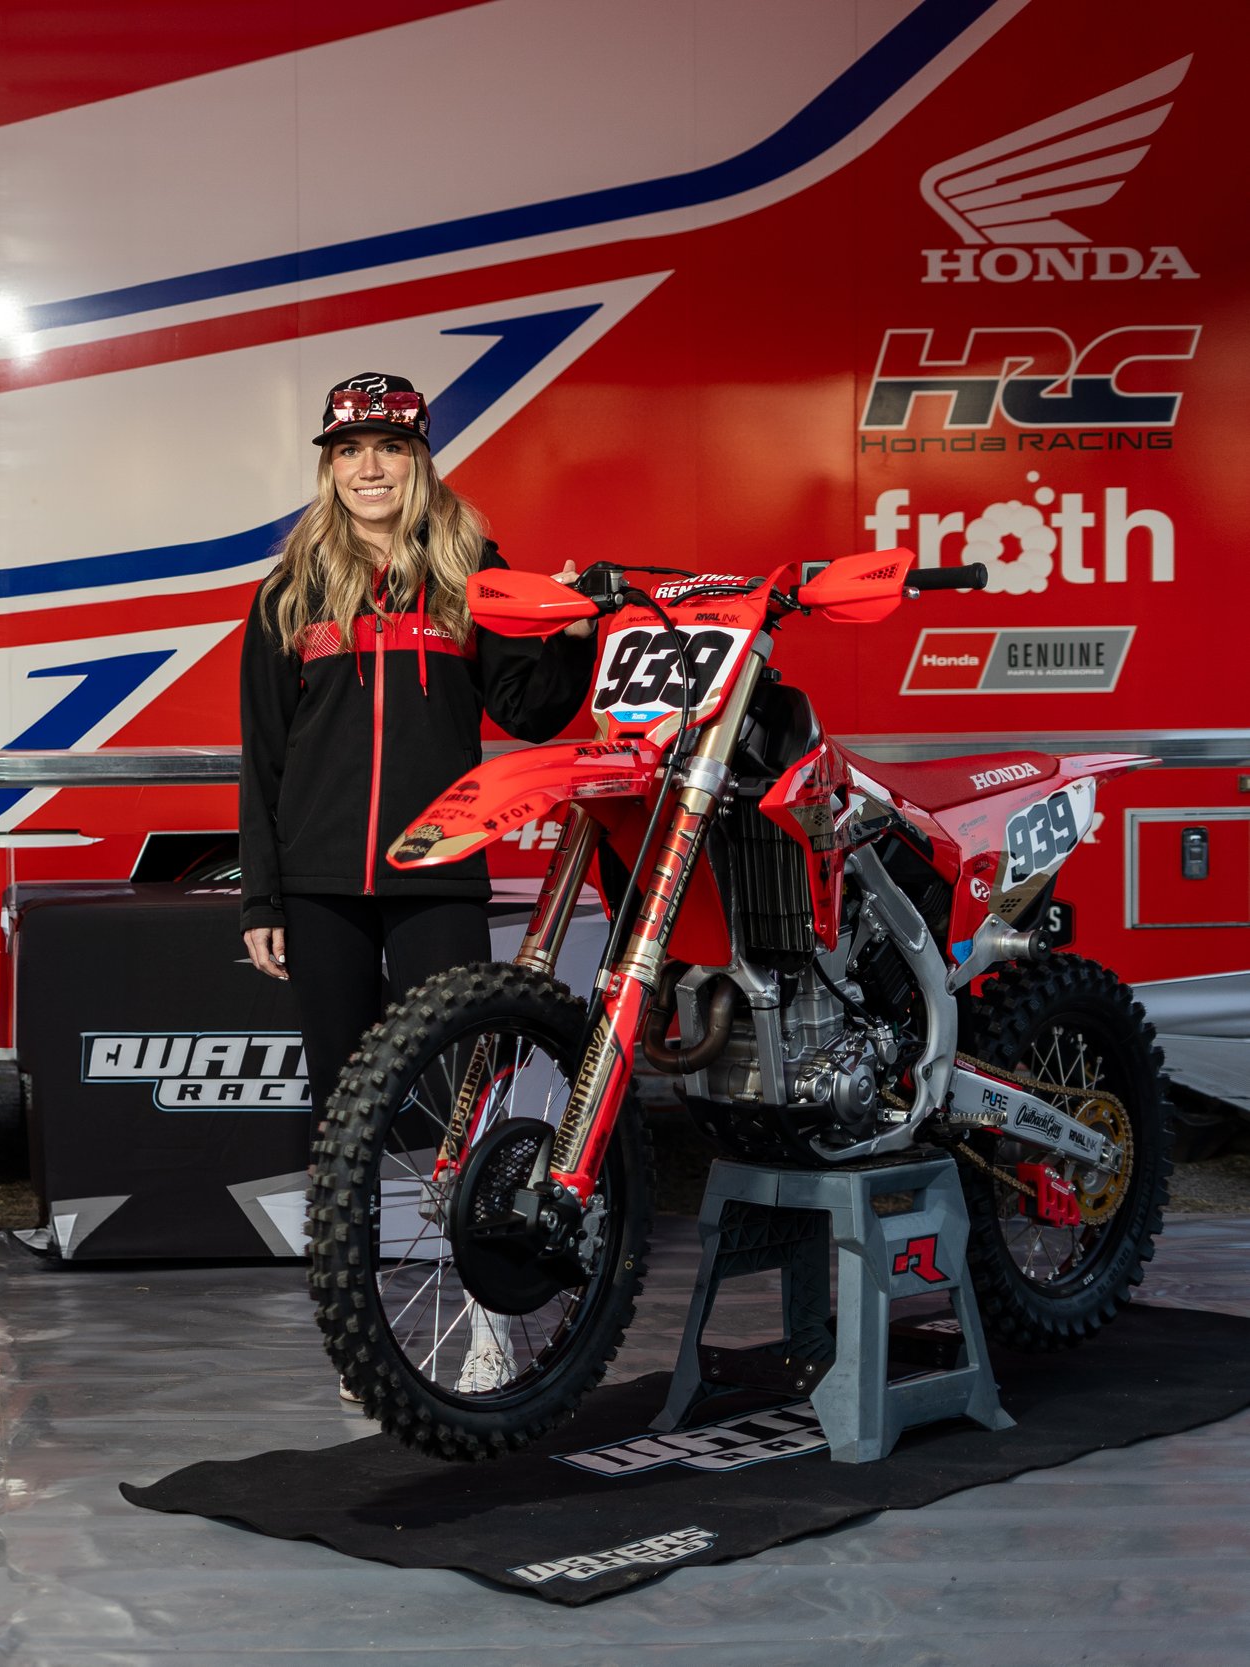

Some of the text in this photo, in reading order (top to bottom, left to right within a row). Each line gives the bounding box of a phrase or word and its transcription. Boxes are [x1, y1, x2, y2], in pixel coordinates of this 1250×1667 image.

[921, 246, 1201, 283] HONDA
[859, 325, 1202, 430] HRC
[861, 431, 1173, 453] Honda RACING
[864, 487, 1174, 594] froth
[694, 612, 720, 621] RIVAL
[722, 614, 741, 623] INK
[412, 627, 453, 639] OND
[922, 654, 979, 666] Honda
[1007, 643, 1105, 667] GENUINE
[594, 630, 734, 710] 939
[970, 763, 1041, 790] HONDA
[501, 804, 534, 823] FOX
[1007, 791, 1078, 883] 939
[657, 815, 711, 948] SUSPENSION
[982, 1089, 1009, 1111] PURE
[1068, 1129, 1086, 1146] RIVAL
[512, 1527, 715, 1583] WATERS
